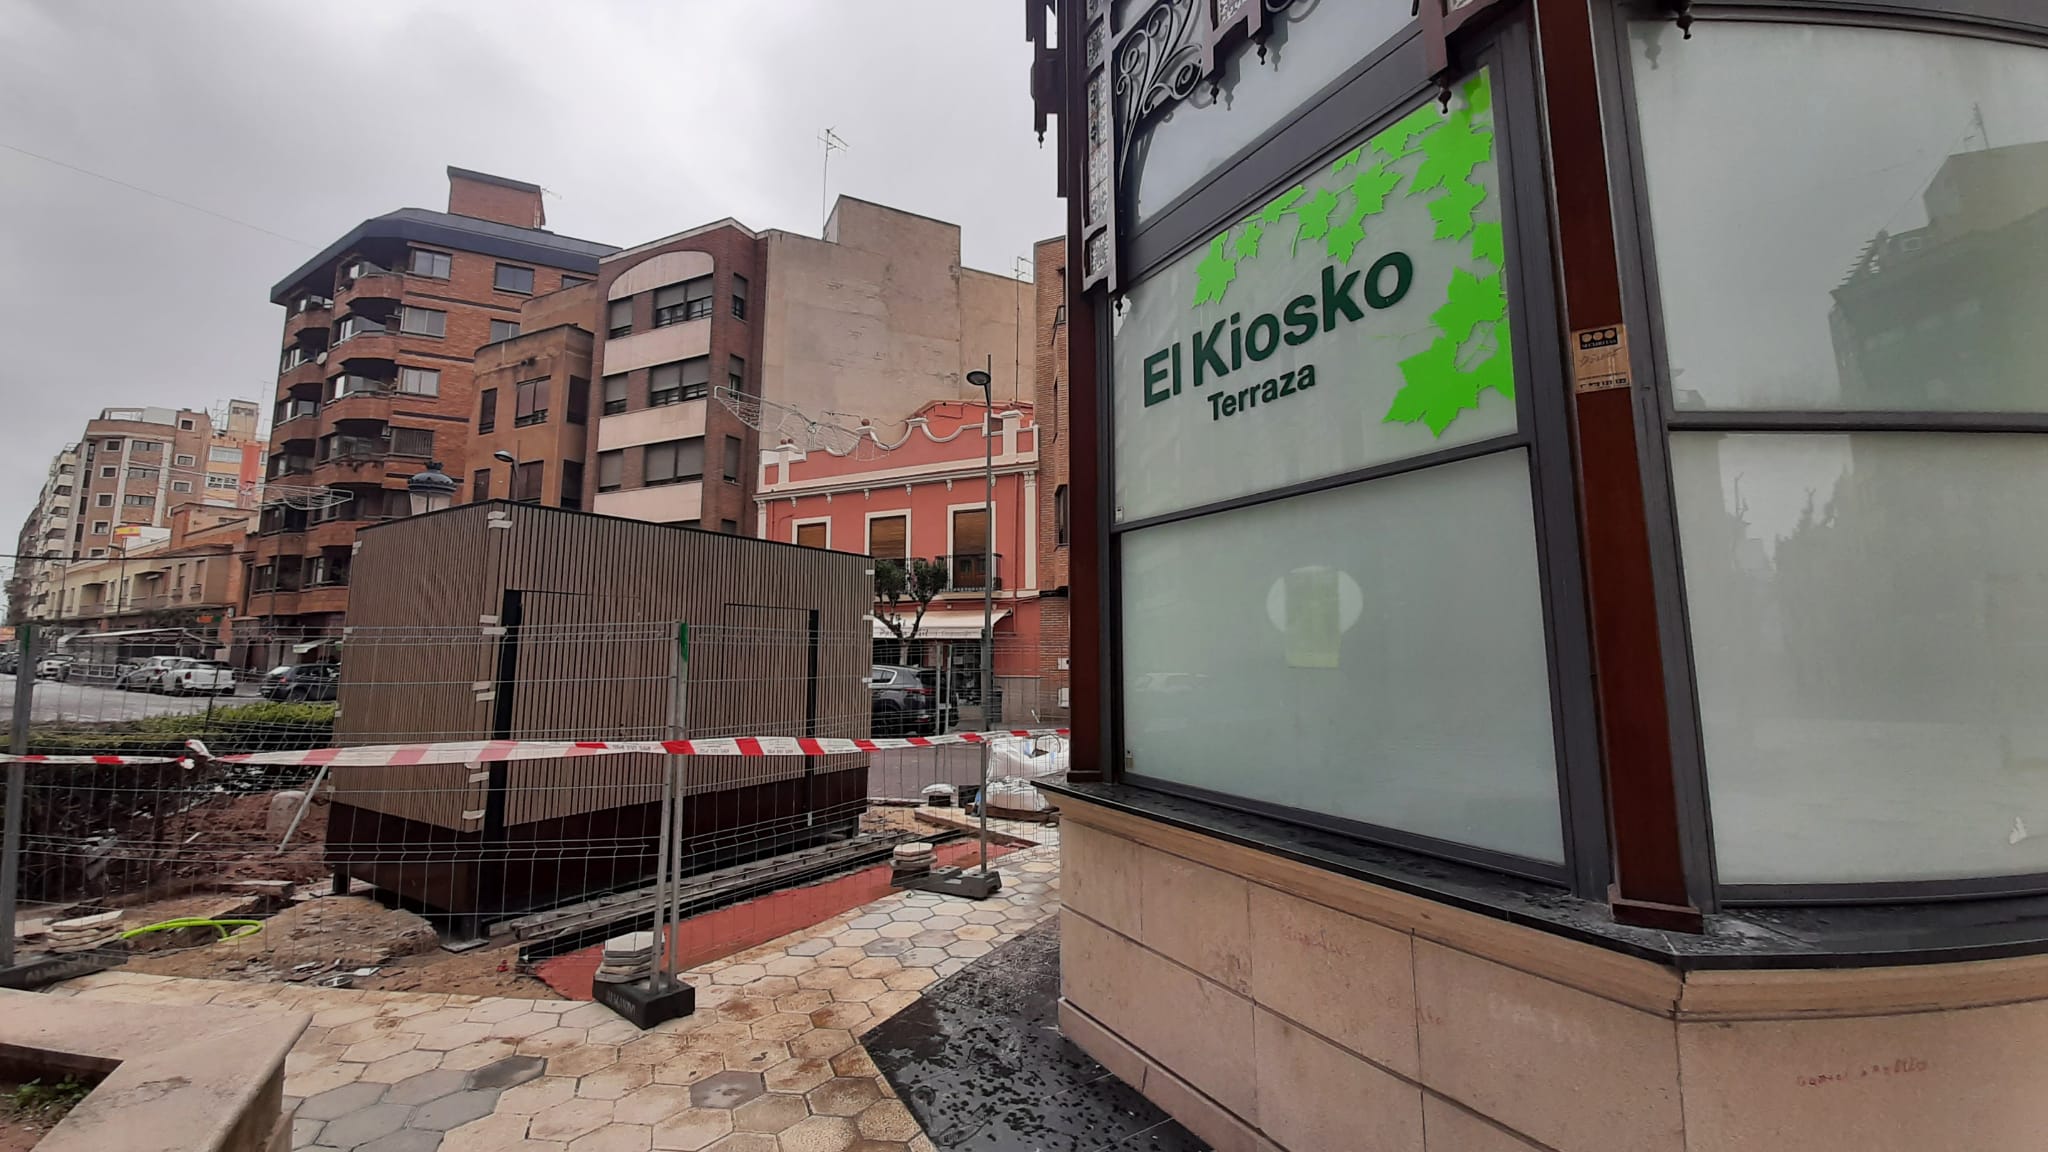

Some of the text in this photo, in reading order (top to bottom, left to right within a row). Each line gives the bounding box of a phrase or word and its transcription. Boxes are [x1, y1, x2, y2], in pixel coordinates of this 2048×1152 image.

[1143, 251, 1414, 408] El Kiosko
[1207, 364, 1316, 421] Terraza
